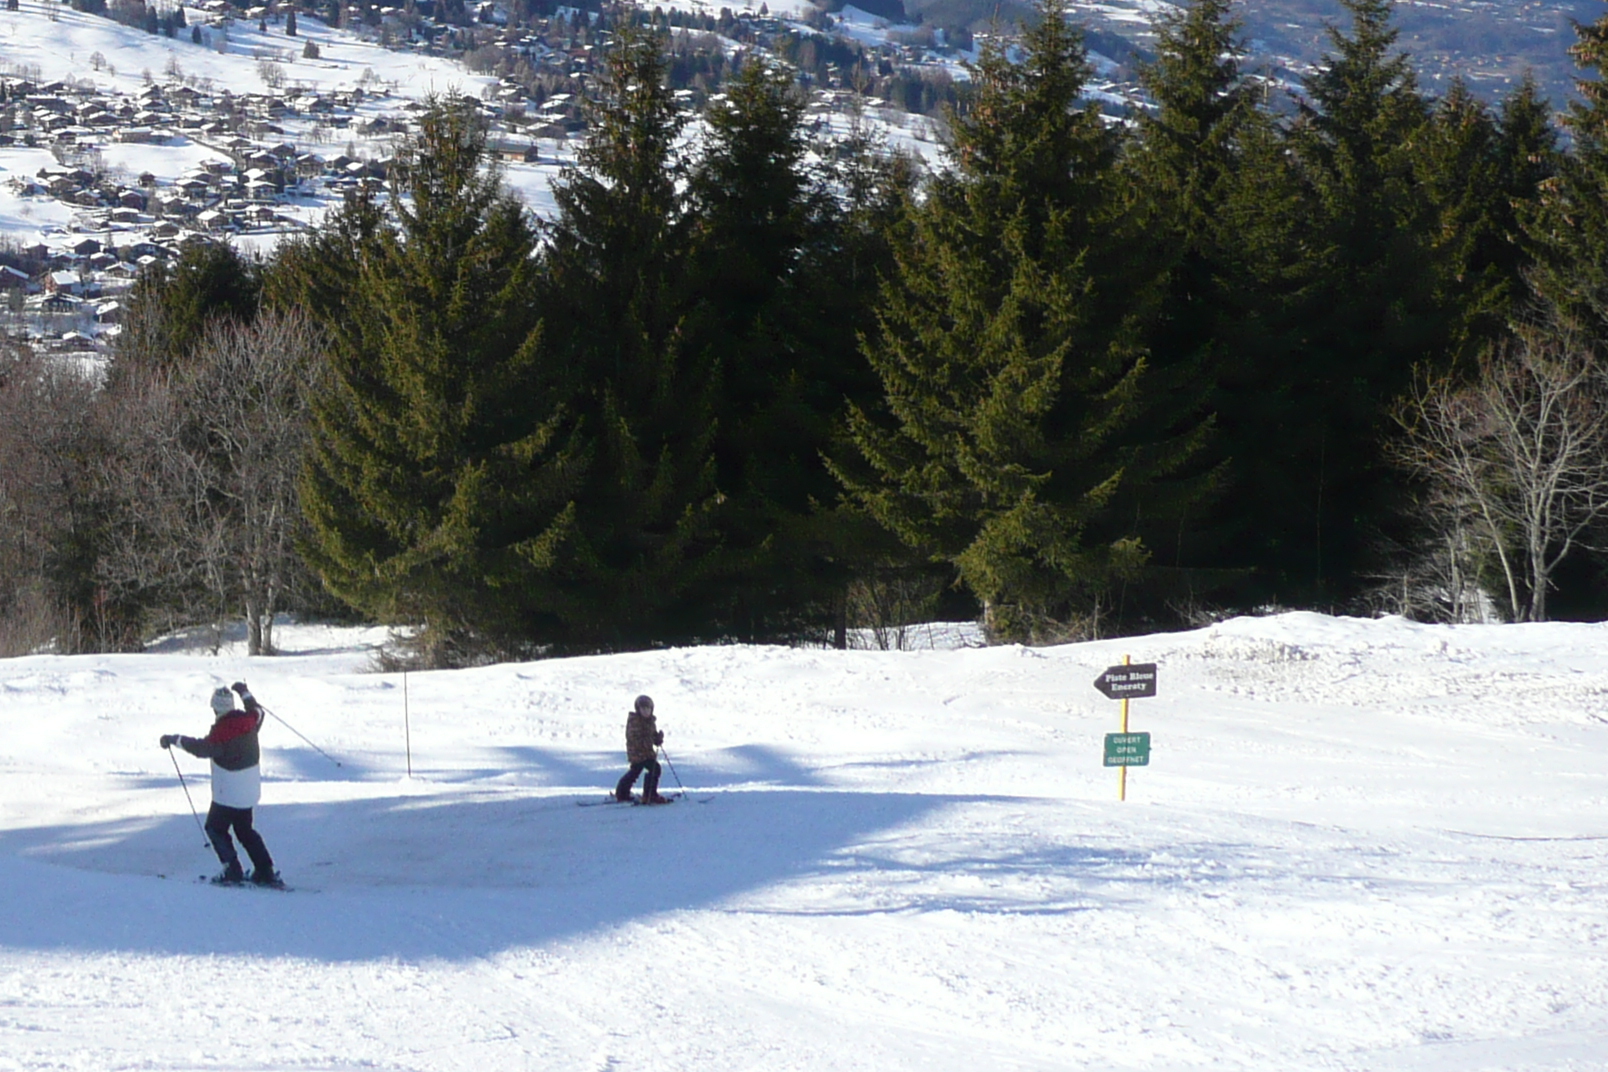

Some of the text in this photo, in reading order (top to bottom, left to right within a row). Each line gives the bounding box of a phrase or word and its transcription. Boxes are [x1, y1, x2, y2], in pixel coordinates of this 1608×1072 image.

[1105, 672, 1153, 683] Piste Bleue
[1113, 736, 1141, 744] OUVERT
[1116, 746, 1137, 754] OPEN
